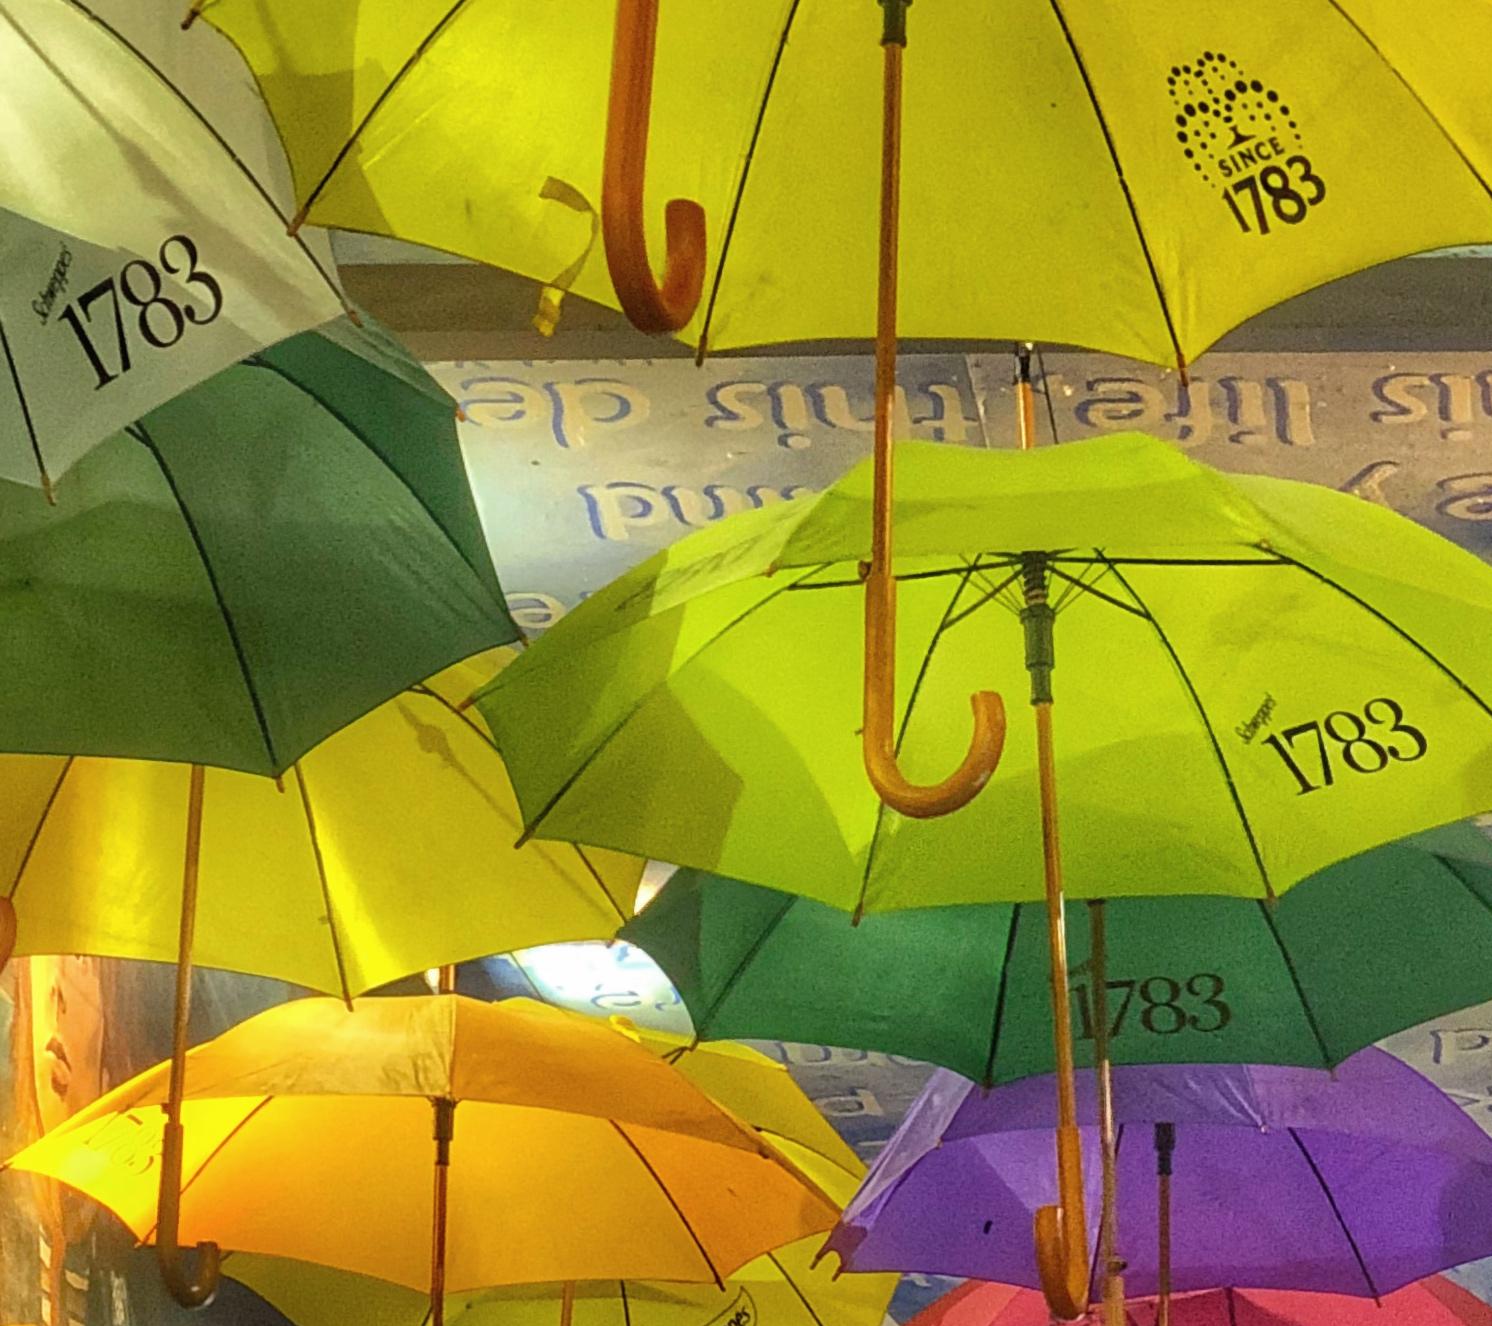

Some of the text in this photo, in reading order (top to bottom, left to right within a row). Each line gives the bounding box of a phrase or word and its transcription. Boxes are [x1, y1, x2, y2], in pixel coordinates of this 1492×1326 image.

[1218, 136, 1285, 178] SINCE
[1222, 155, 1326, 235] 1783
[57, 235, 223, 390] 1783
[1261, 697, 1428, 796] 1783
[1069, 973, 1232, 1040] 1783
